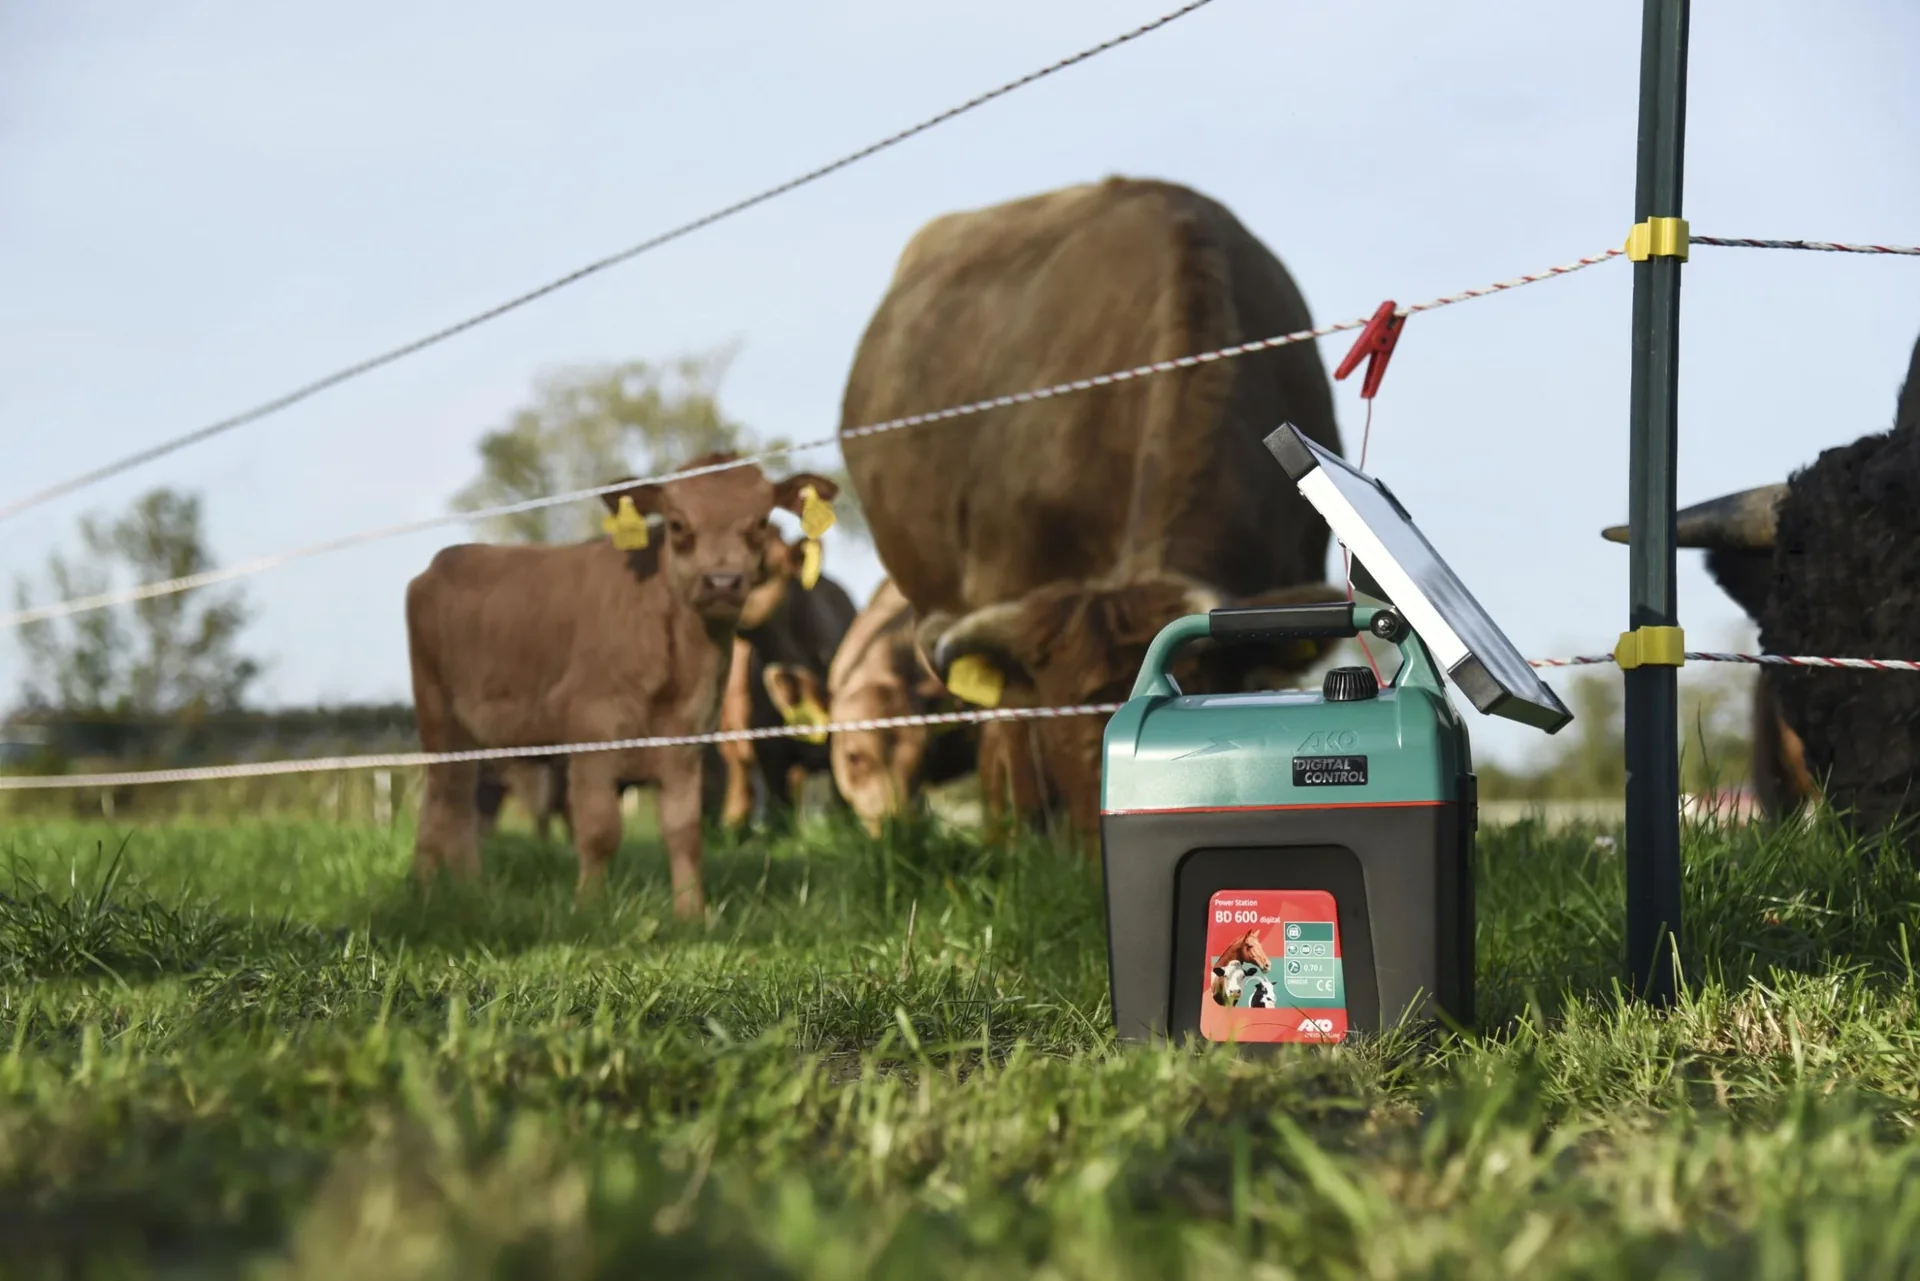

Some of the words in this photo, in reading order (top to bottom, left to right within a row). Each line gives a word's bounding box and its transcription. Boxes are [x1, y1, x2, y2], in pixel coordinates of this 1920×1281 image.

[1295, 759, 1351, 770] DIGITAL
[1304, 771, 1365, 784] CONTROL
[1214, 899, 1234, 907] Power
[1235, 899, 1258, 907] Station
[1215, 910, 1232, 923] BD
[1234, 910, 1258, 923] 600
[1260, 916, 1281, 924] digital
